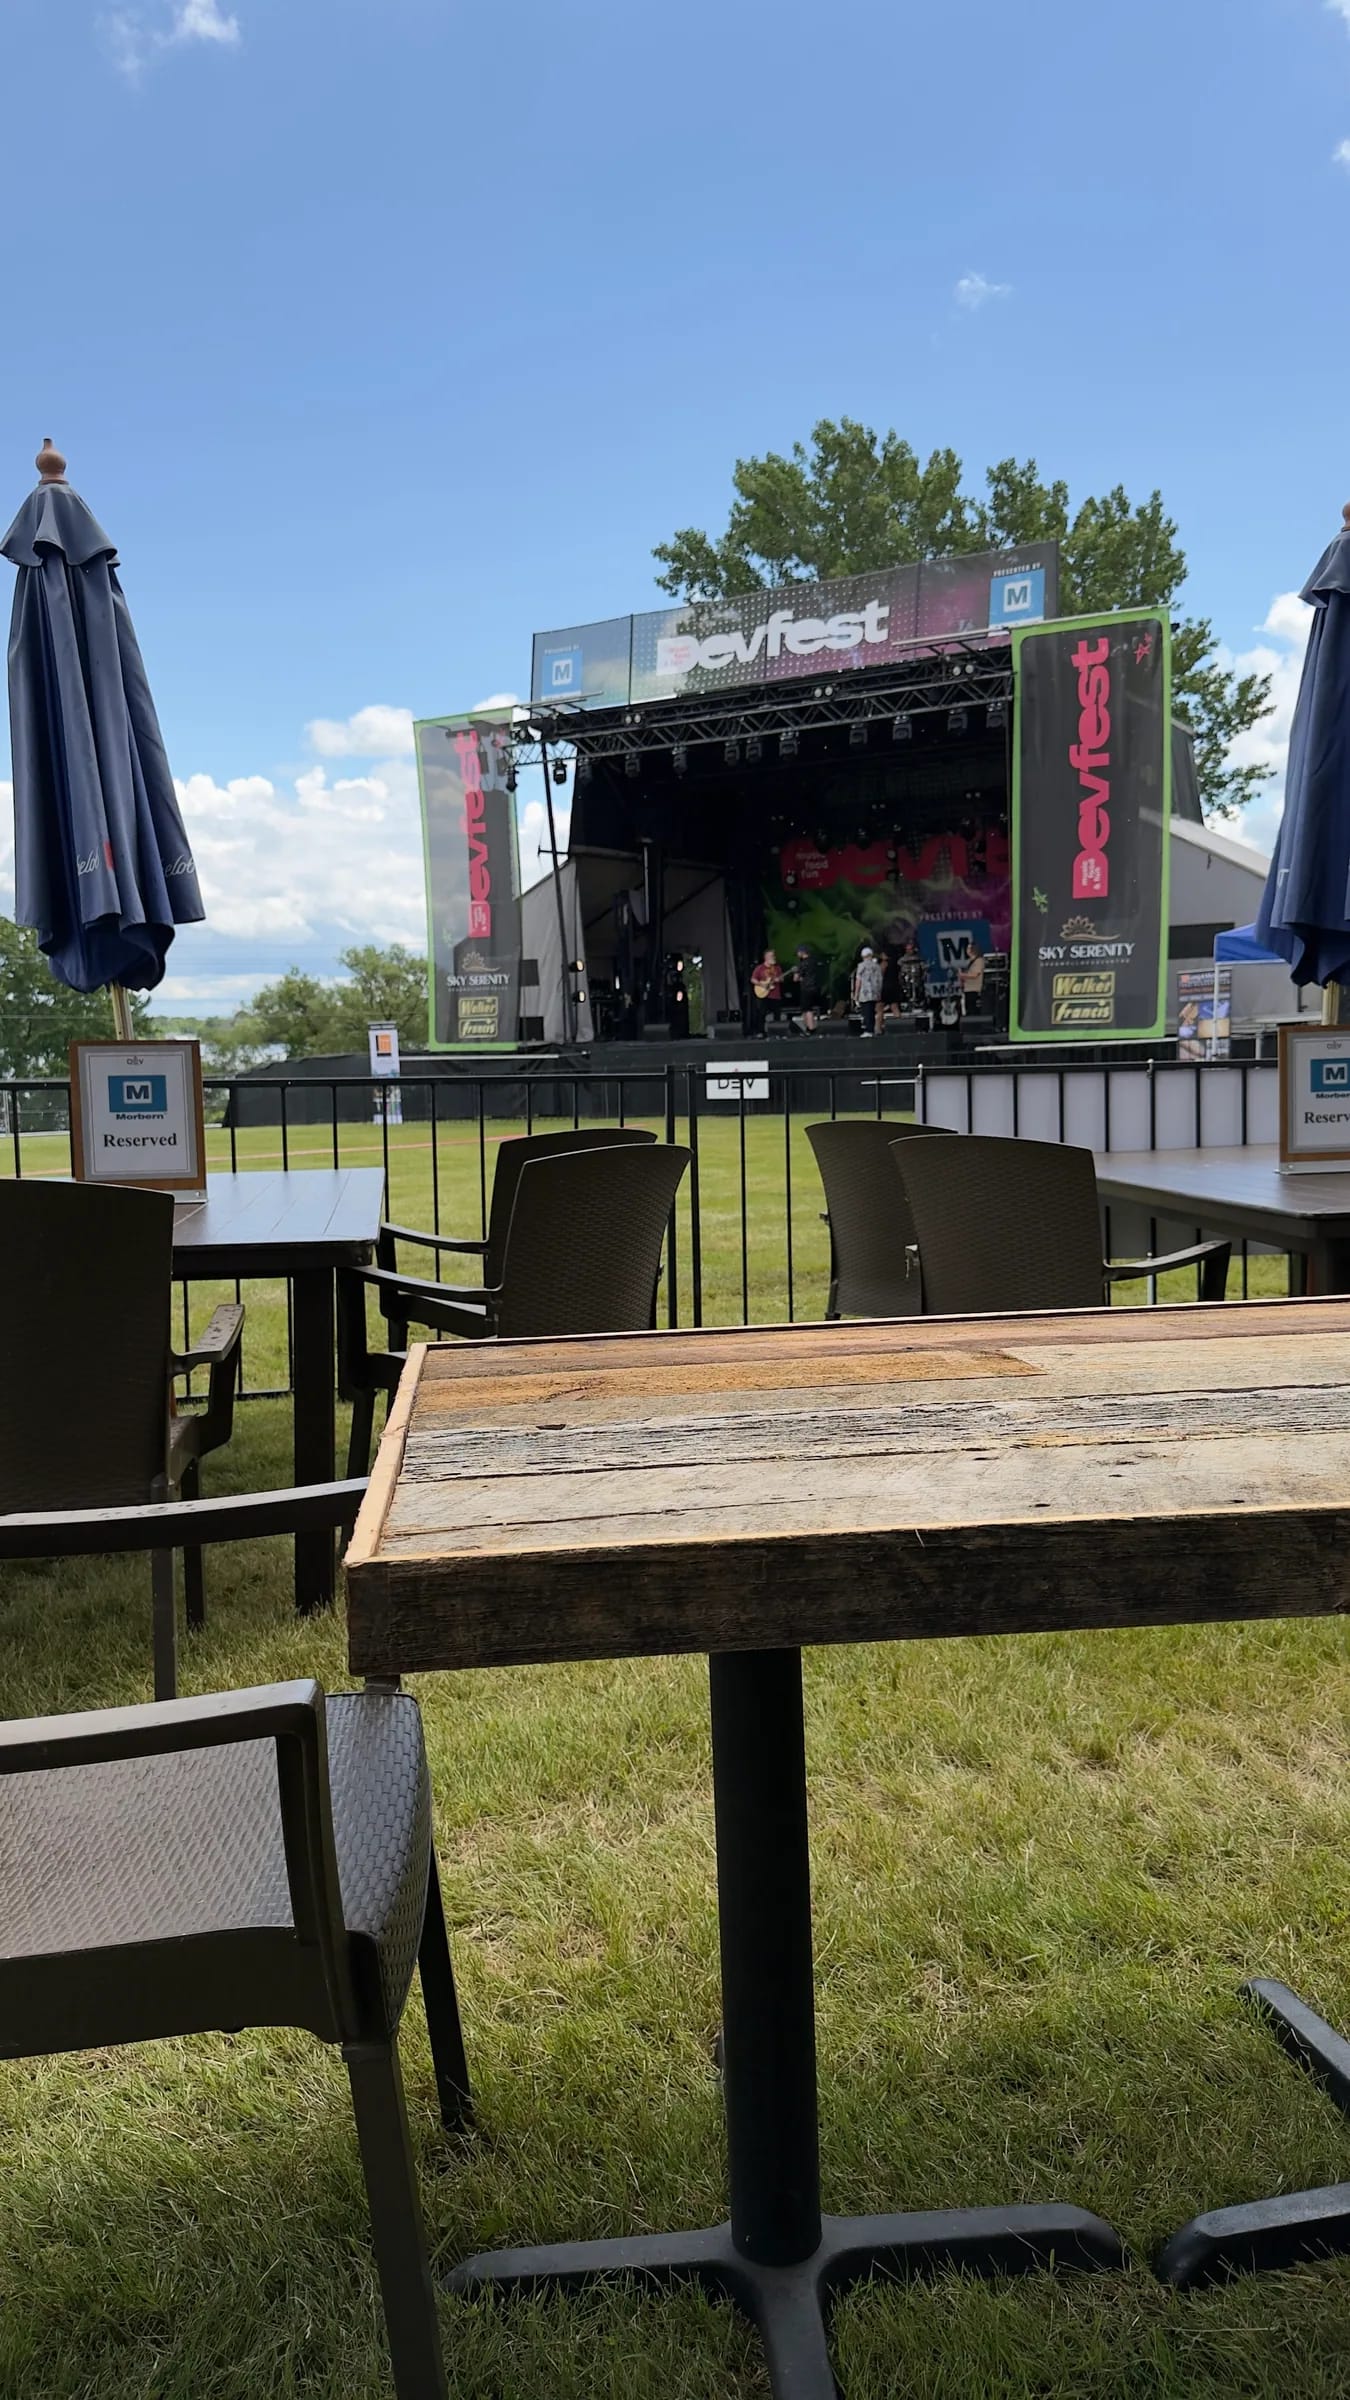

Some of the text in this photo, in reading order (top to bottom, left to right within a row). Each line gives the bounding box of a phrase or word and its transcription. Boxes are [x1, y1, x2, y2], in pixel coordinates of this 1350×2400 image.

[1006, 585, 1028, 606] M
[656, 599, 889, 675] Devfest
[1069, 637, 1111, 899] Devfest
[1038, 942, 1135, 960] SKY SERENITY
[447, 974, 510, 987] SKY SERENITY
[1325, 1066, 1345, 1081] M
[126, 1085, 150, 1100] M
[116, 1113, 164, 1121] Morbern
[104, 1132, 177, 1148] Reserved
